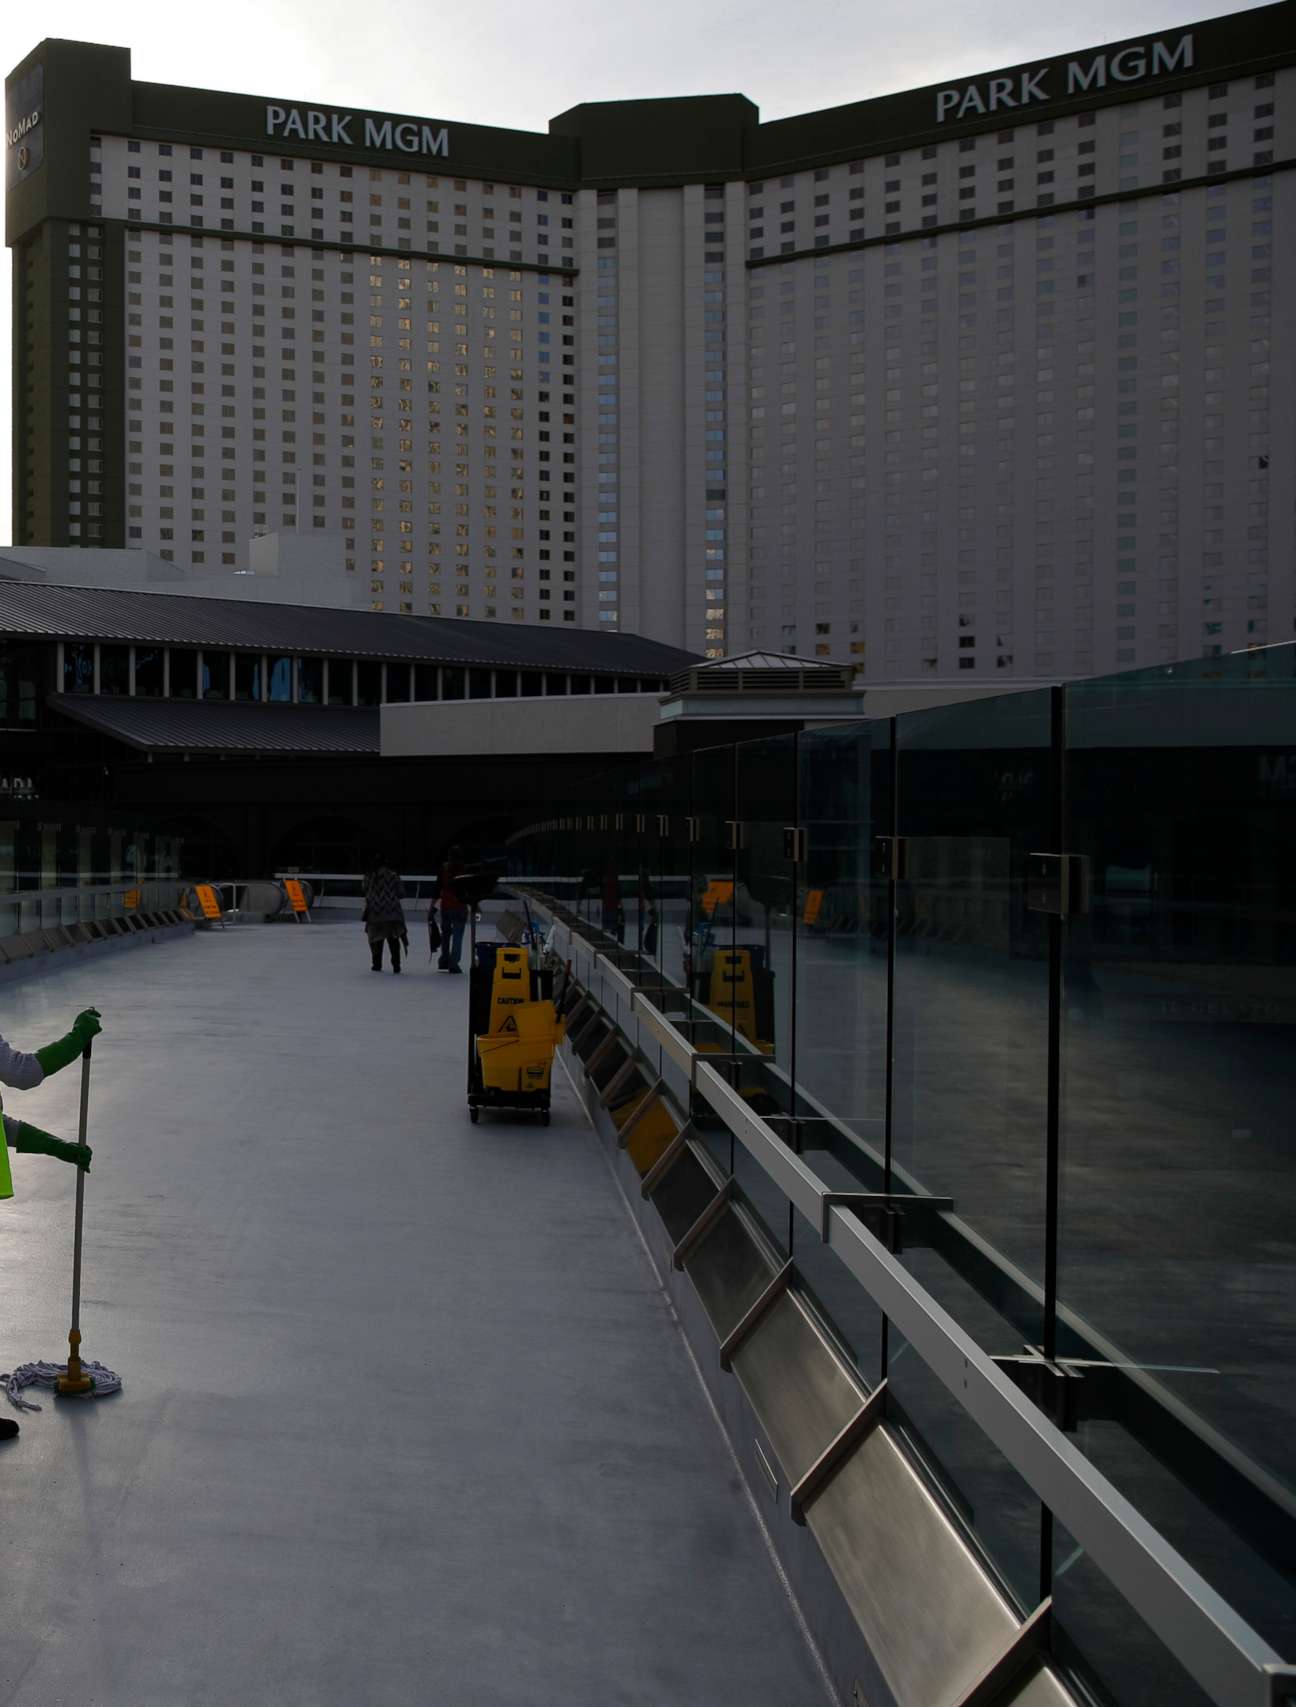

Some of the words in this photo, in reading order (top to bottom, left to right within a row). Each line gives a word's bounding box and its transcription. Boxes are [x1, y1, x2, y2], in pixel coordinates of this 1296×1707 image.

[935, 67, 1050, 124] PARK
[1066, 33, 1195, 95] MGM
[265, 105, 353, 145] PARK
[364, 117, 450, 158] MGM
